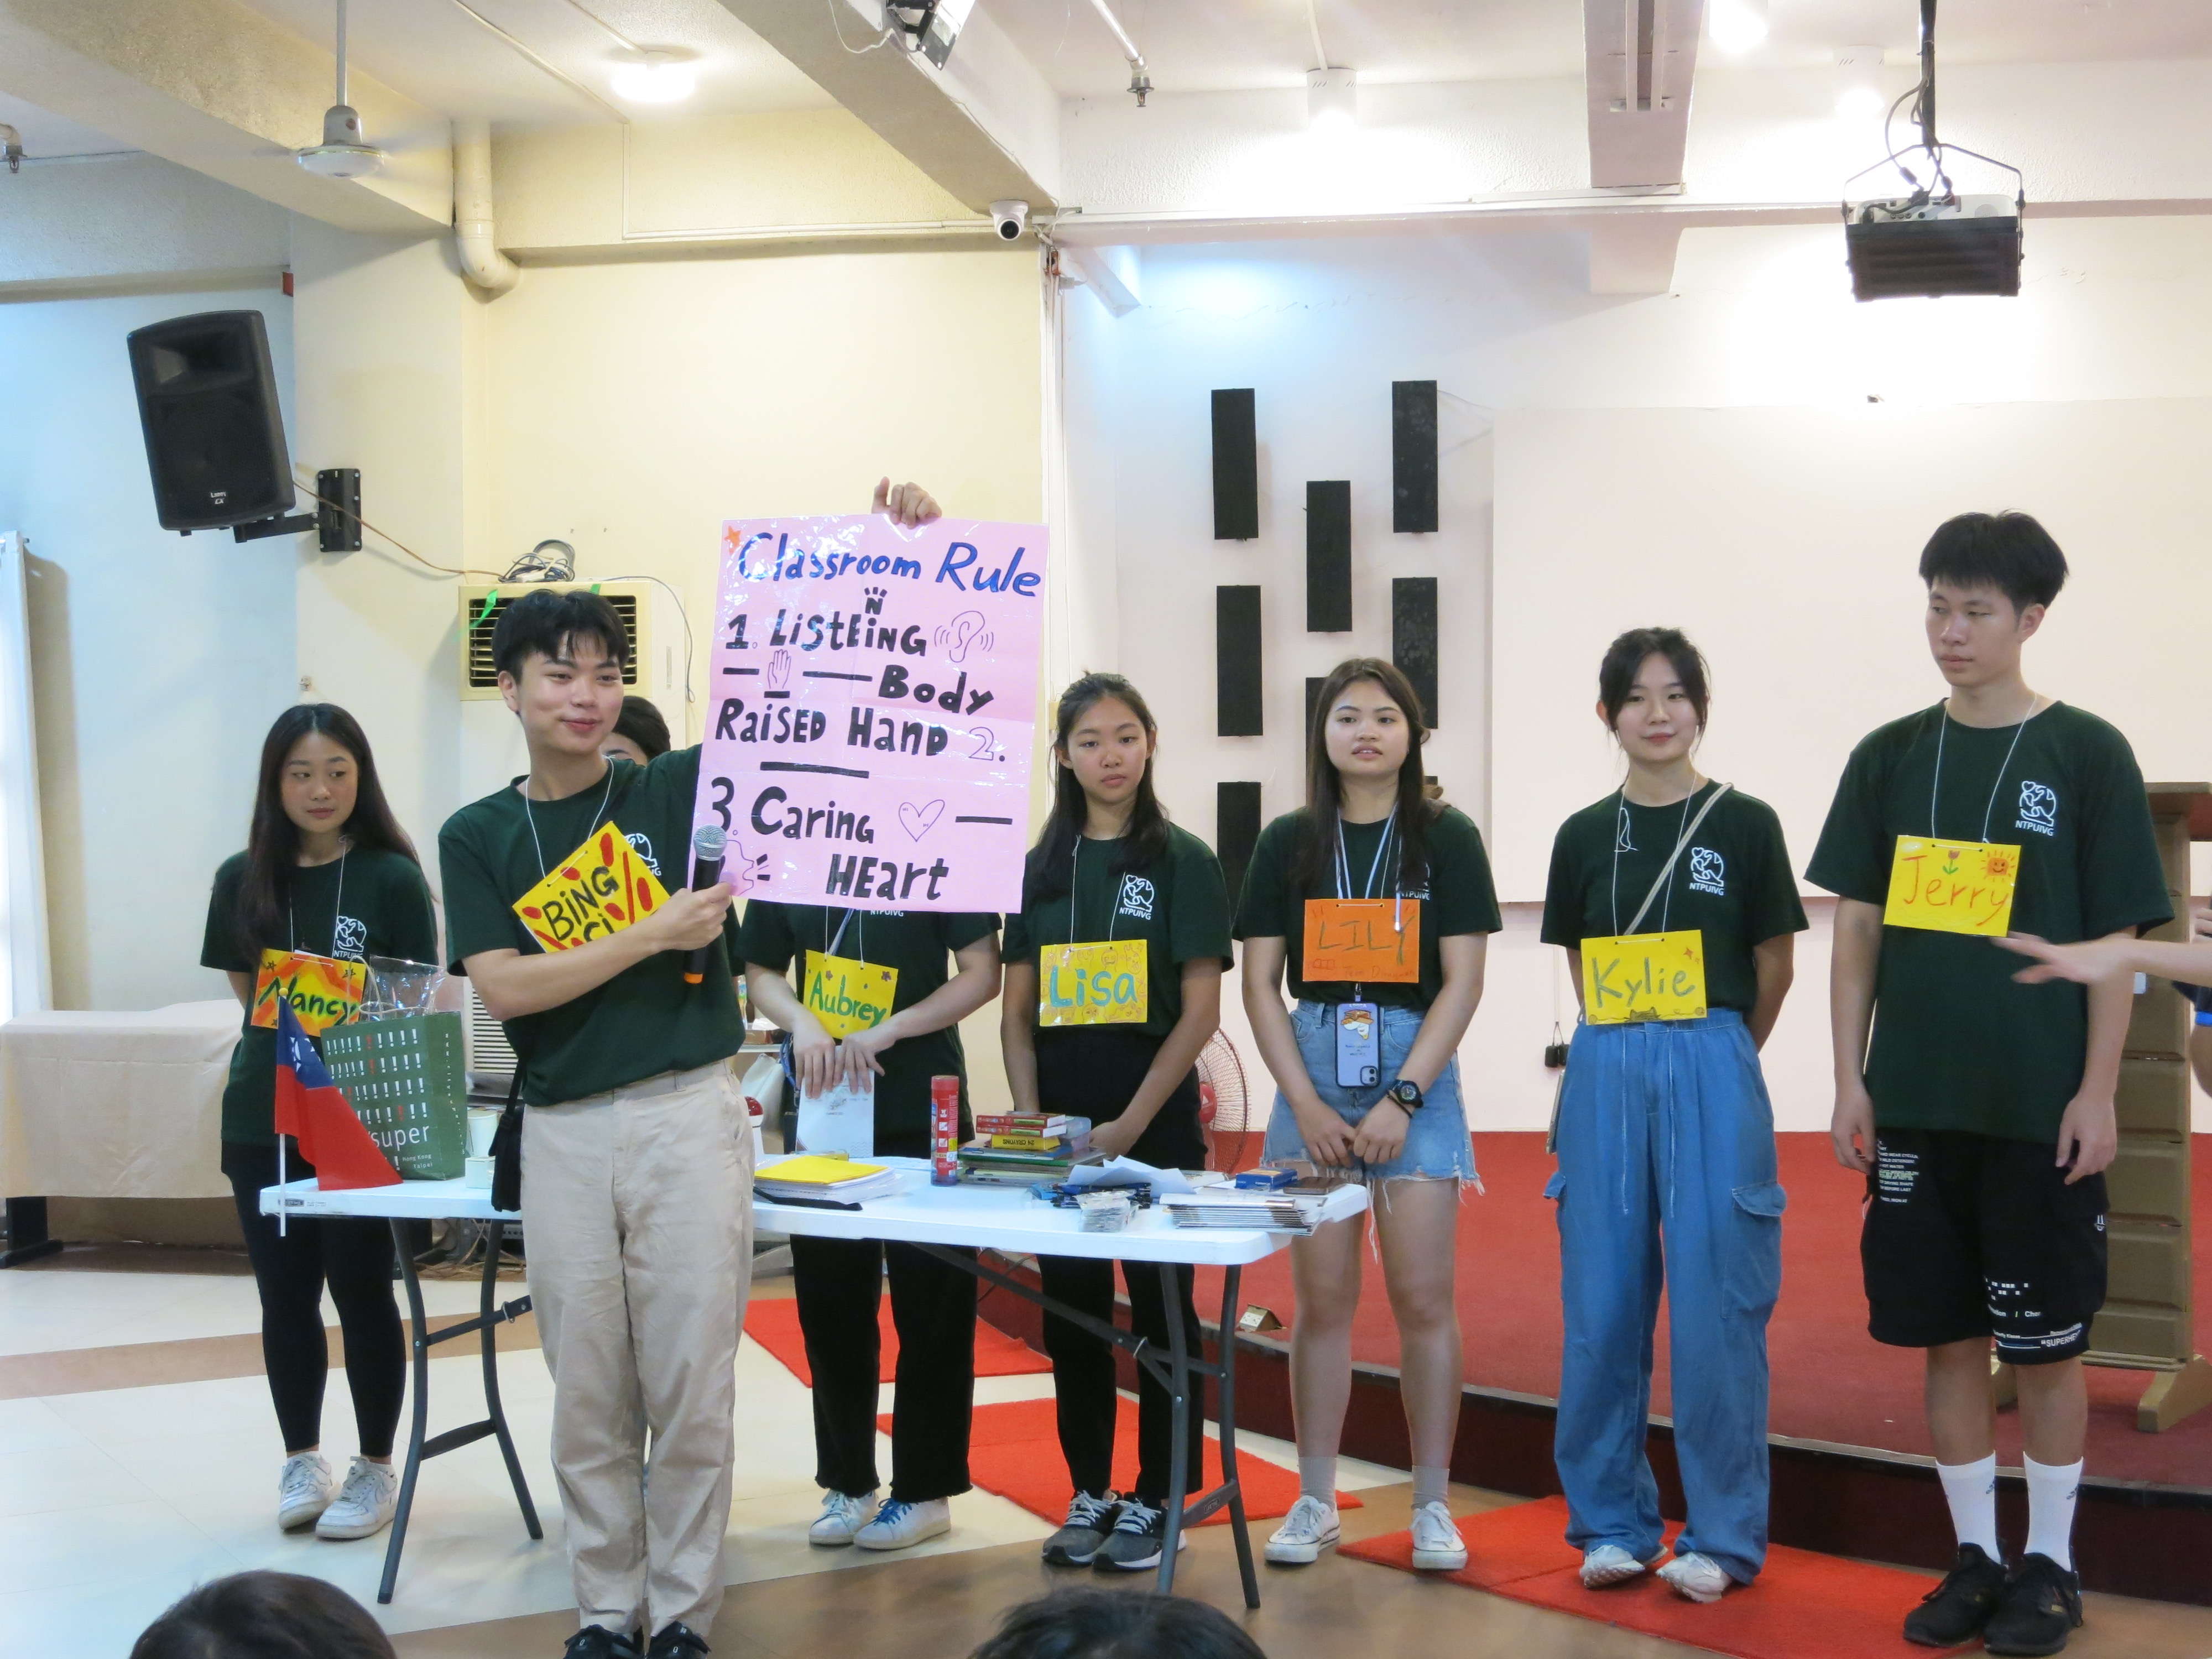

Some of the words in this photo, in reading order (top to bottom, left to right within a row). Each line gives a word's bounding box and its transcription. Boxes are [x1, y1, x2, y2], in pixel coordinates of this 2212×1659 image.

[738, 532, 922, 581] Classroom
[935, 541, 1041, 597] Rule
[878, 664, 994, 716] Body
[2015, 820, 2054, 837] NTPUIVG
[1119, 907, 1152, 920] NTPUIVG
[1689, 882, 1724, 896] NTPUIVG
[1902, 854, 2010, 927] Jerry
[1317, 915, 1416, 966] LILY
[258, 972, 358, 1026] Nancy
[809, 970, 887, 1029] Aubrey
[1050, 964, 1138, 1008] Lisa
[1592, 957, 1696, 1008] Kylie
